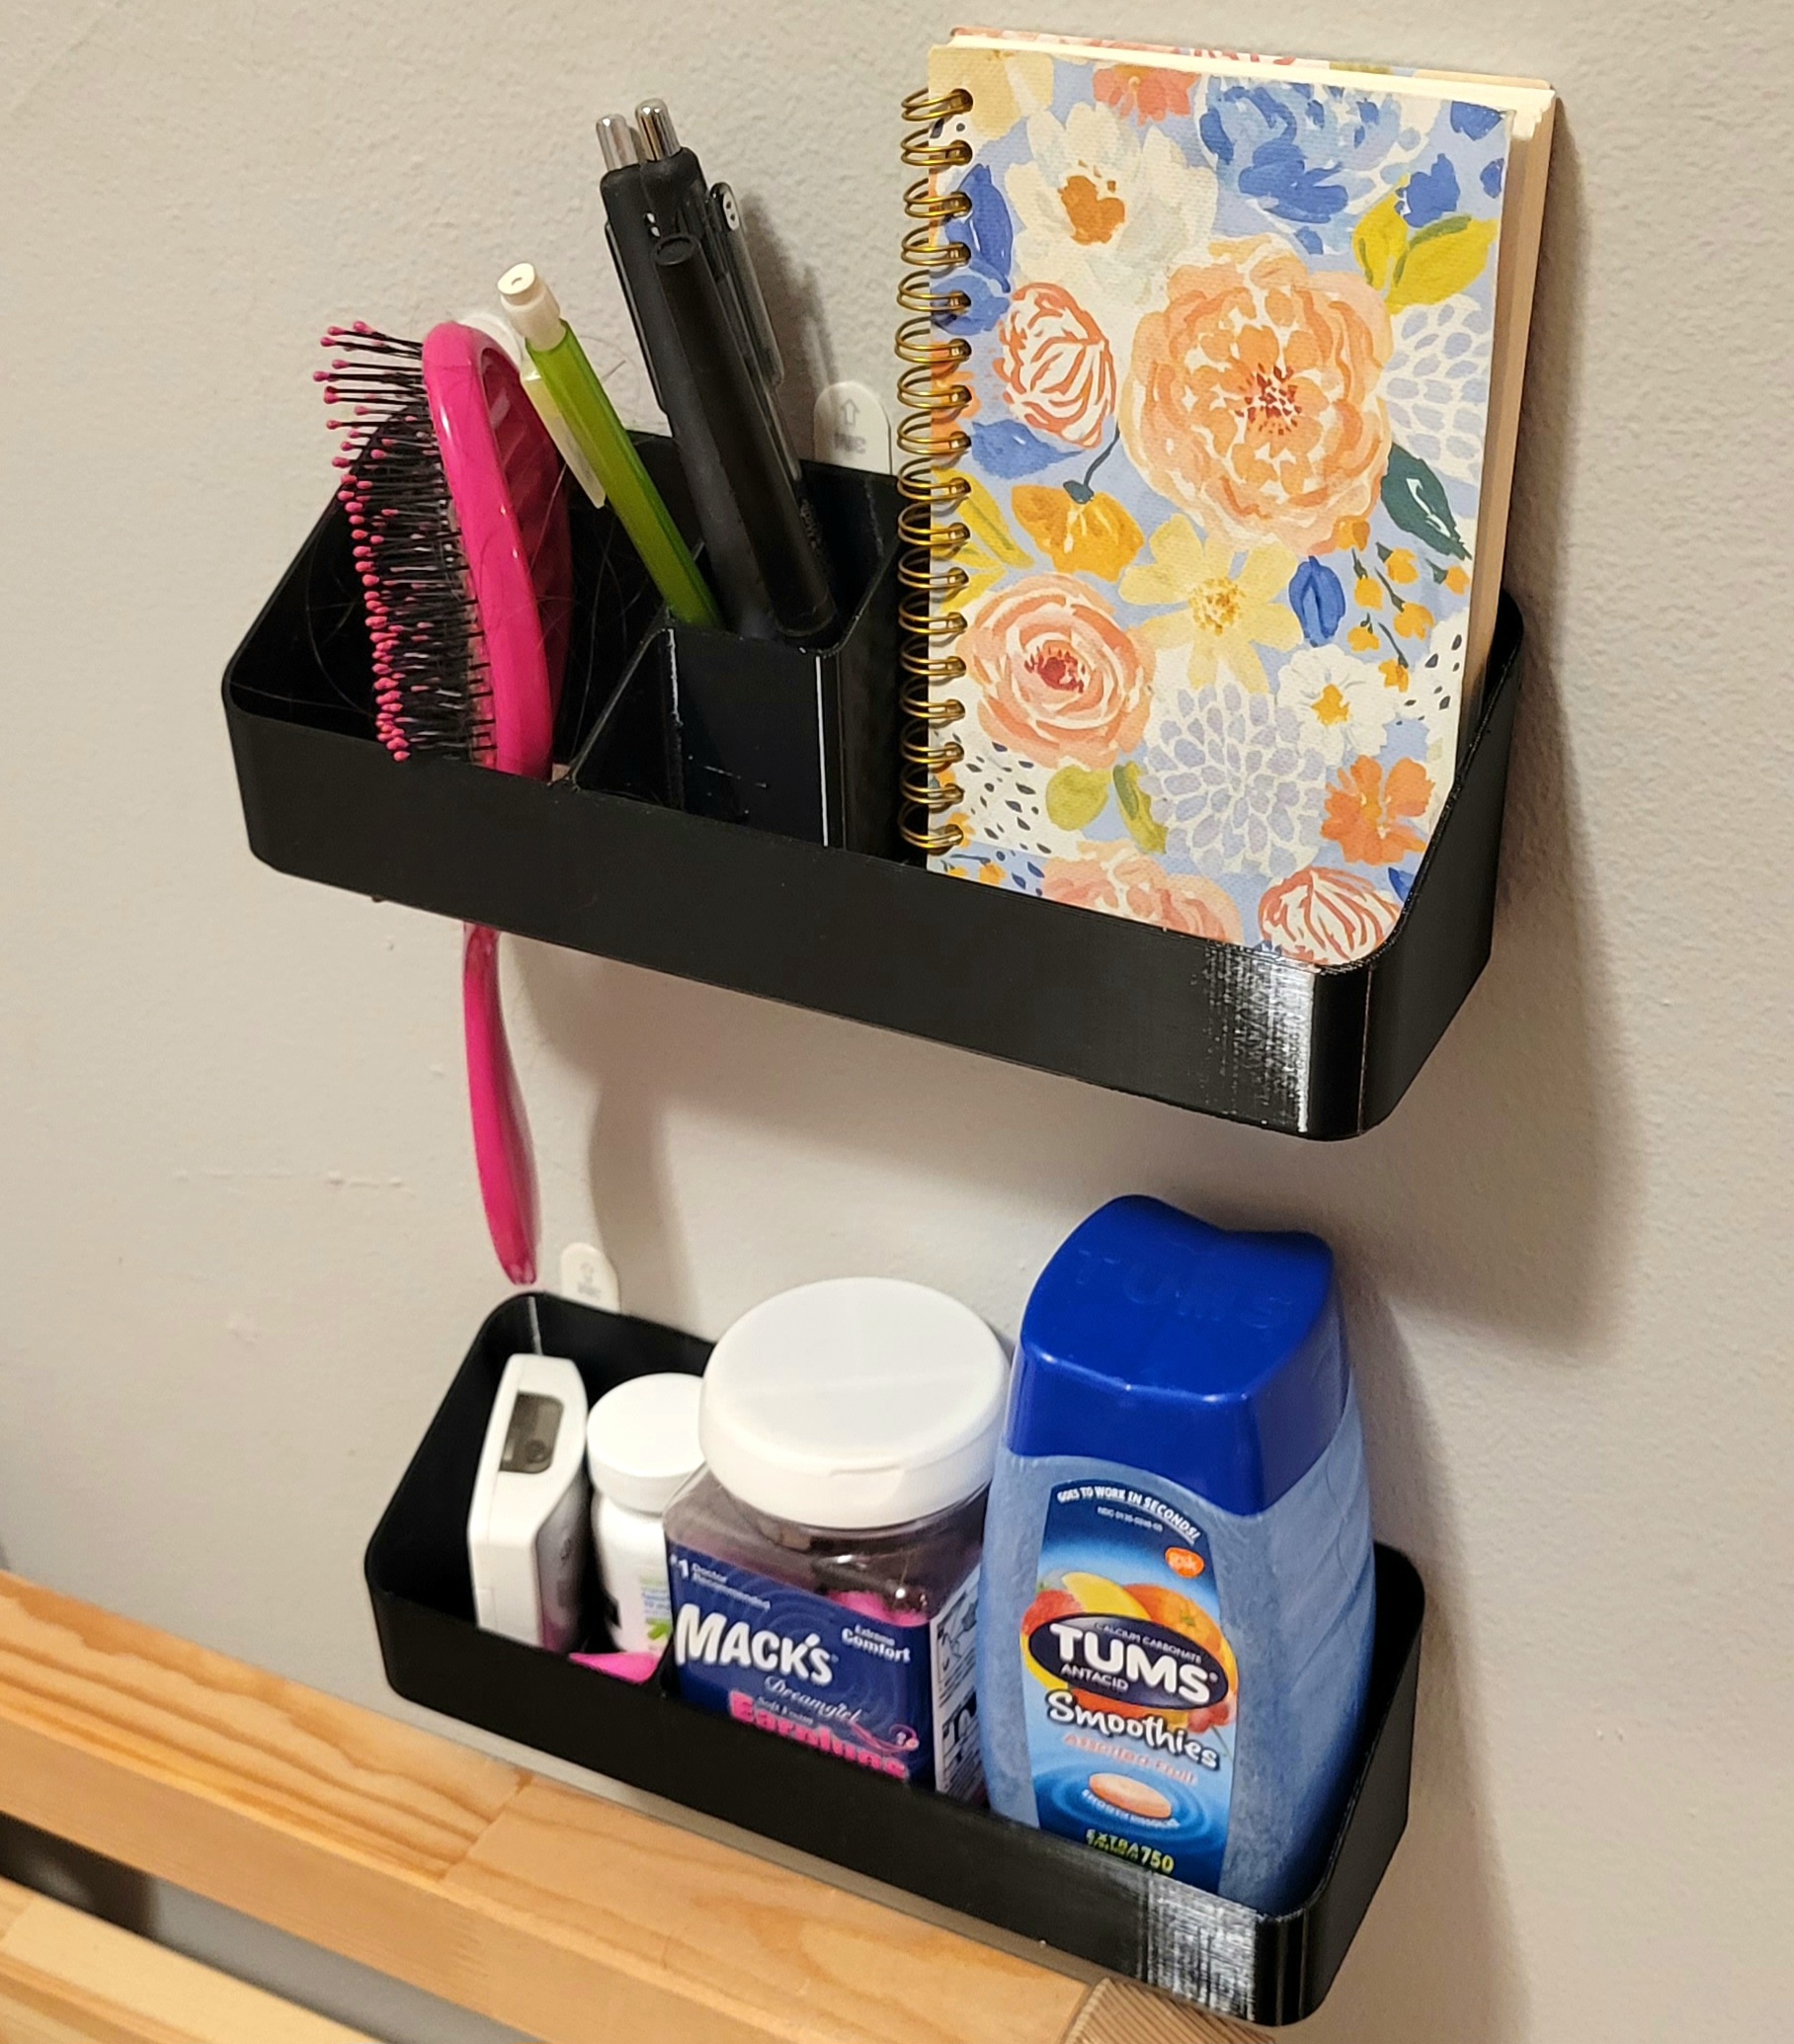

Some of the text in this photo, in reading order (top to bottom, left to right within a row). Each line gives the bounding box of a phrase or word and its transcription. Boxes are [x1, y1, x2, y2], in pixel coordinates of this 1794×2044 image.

[1057, 1485, 1201, 1540] GOES TO WORK IN SECONDS!
[675, 1602, 833, 1686] MACK'S
[842, 1627, 911, 1664] Comfort
[1049, 1622, 1211, 1705] TUMS
[1094, 1621, 1202, 1665] CALCIUM CARBONATE
[1061, 1664, 1129, 1692] ANTACID
[1047, 1689, 1219, 1769] Smoothies
